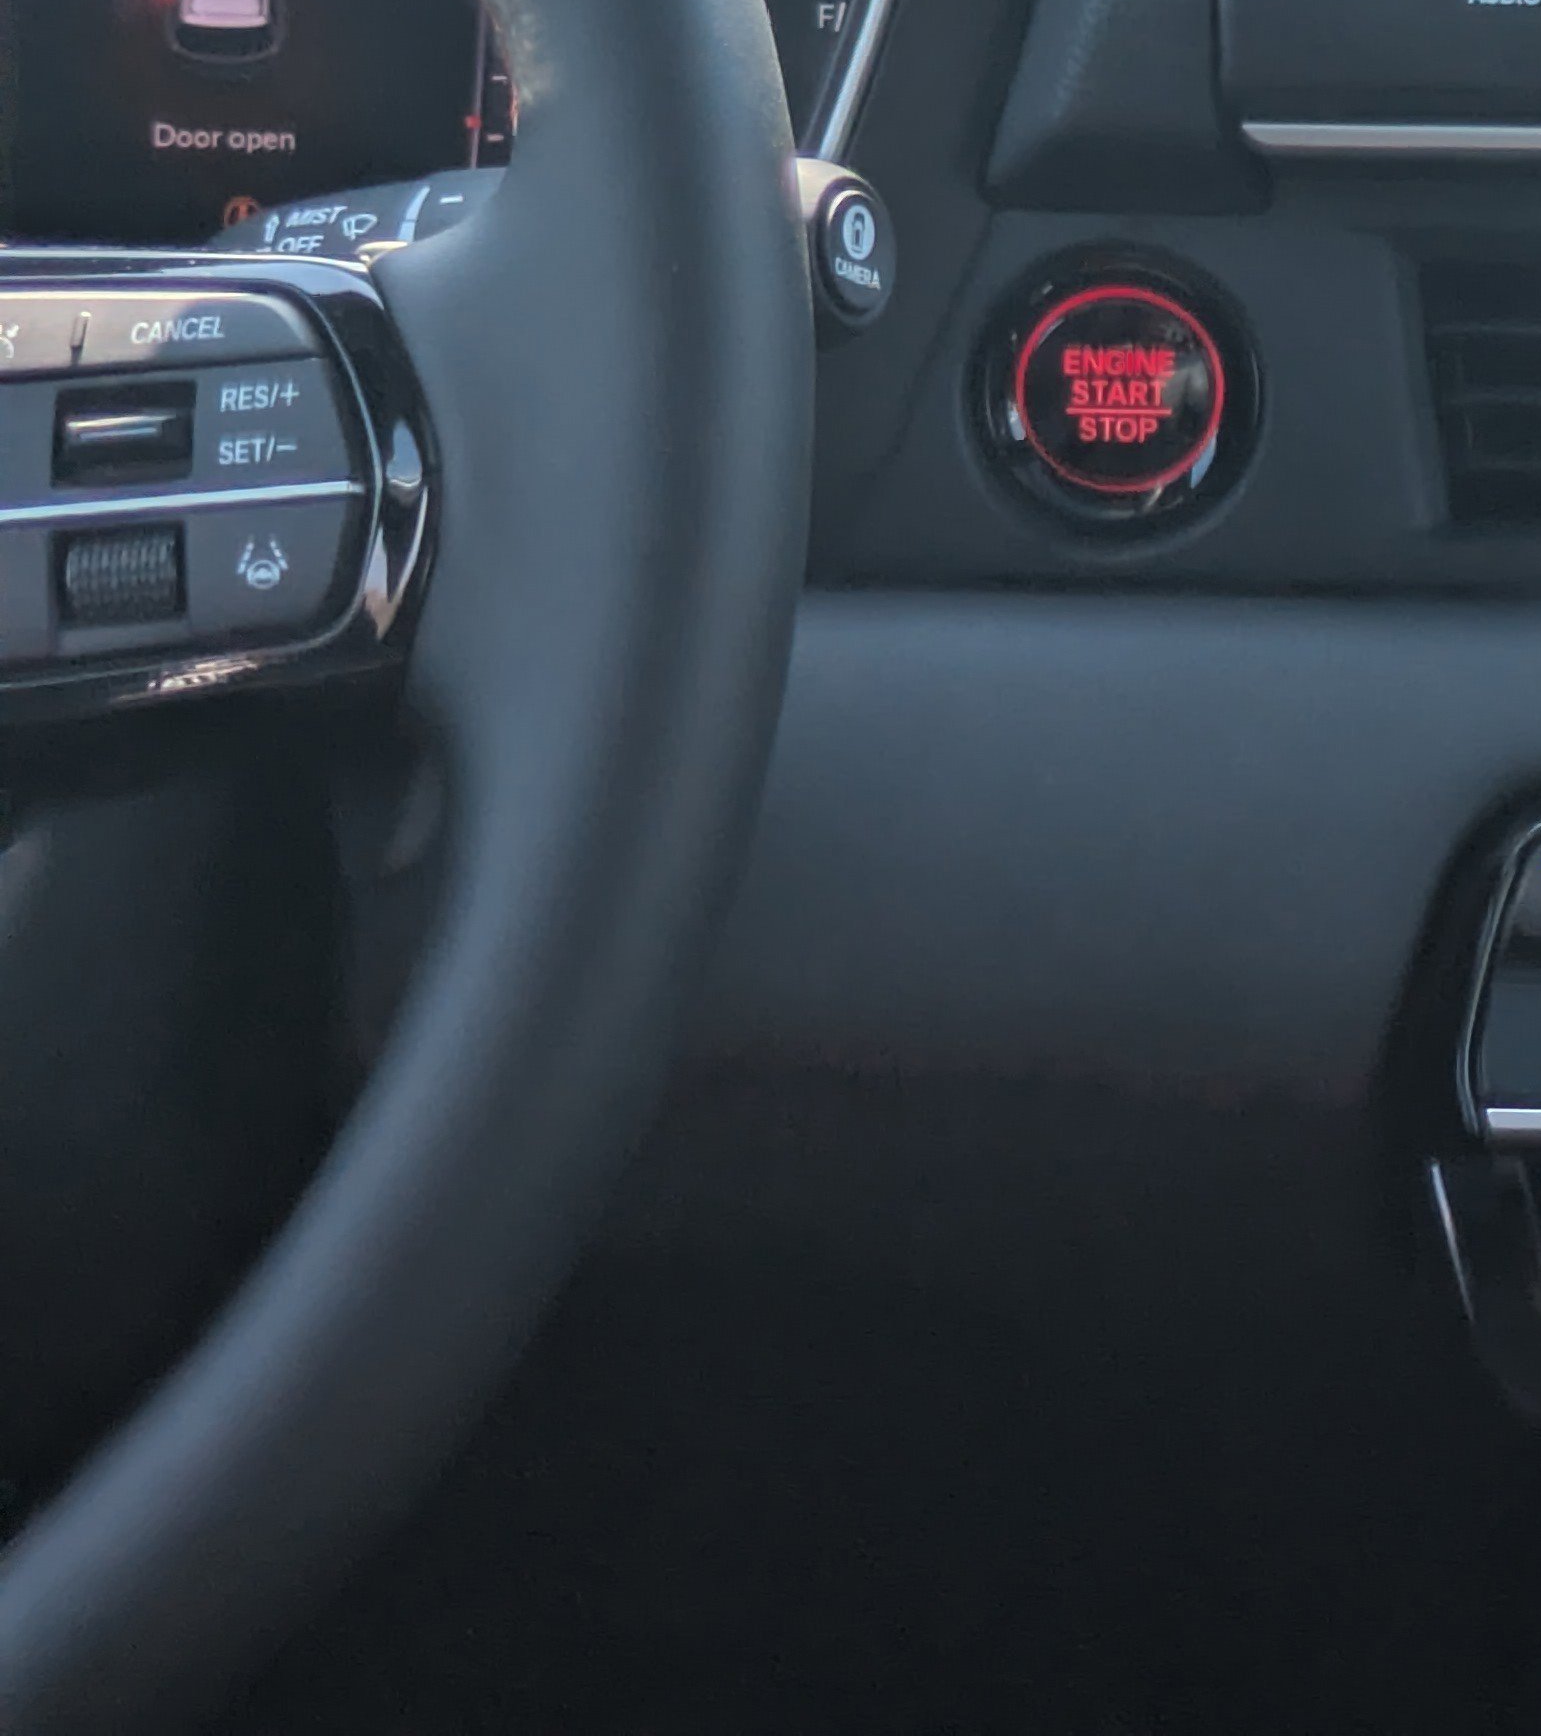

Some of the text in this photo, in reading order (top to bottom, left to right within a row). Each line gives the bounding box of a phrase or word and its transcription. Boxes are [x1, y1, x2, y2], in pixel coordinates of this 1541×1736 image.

[153, 123, 295, 153] Door open
[286, 206, 347, 227] MIST
[278, 235, 324, 252] OFF
[835, 257, 881, 290] CAMERA
[131, 316, 225, 344] CANCEL
[1063, 347, 1175, 376] ENGINE
[219, 382, 299, 412] RES/+
[1070, 380, 1166, 406] START
[1079, 417, 1158, 443] STOP
